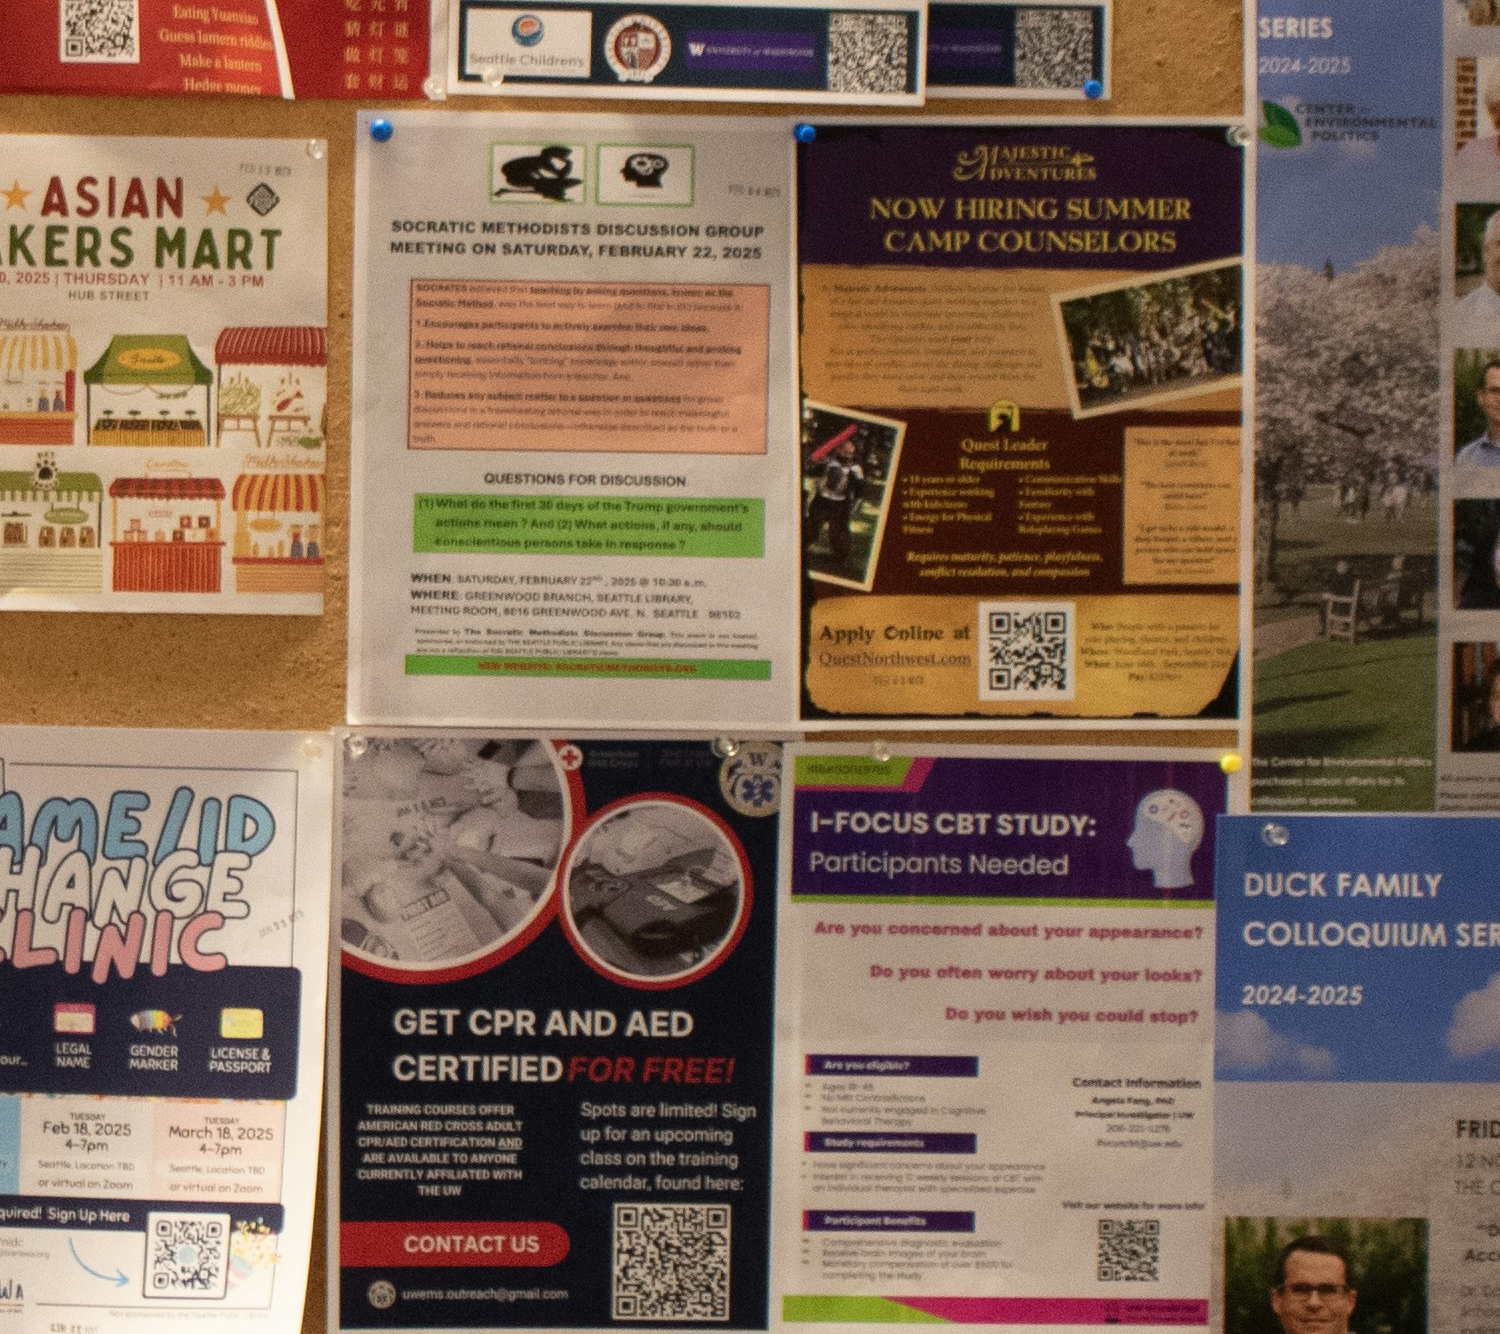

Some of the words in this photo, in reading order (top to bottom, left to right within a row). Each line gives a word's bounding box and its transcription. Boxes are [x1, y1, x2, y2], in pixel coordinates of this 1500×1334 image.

[1259, 57, 1351, 76] 2024-2025
[41, 178, 185, 219] ASIAN
[870, 198, 946, 221] NOW
[955, 199, 1058, 221] HIRING
[1066, 199, 1190, 222] SUMMER
[155, 229, 283, 271] MART
[885, 231, 970, 253] CAMP
[978, 231, 1177, 254] COUNSELORS
[811, 812, 930, 837] I-FOCUS
[936, 813, 991, 837] CBT
[997, 813, 1096, 838] STUDY:
[393, 1055, 562, 1084] CERTIFIED
[568, 1057, 634, 1084] FOR
[643, 1057, 736, 1084] FREE!
[403, 1234, 498, 1255] CONTACT
[507, 1235, 540, 1255] US
[402, 1288, 570, 1303] uwems.outreach@gmail.com
